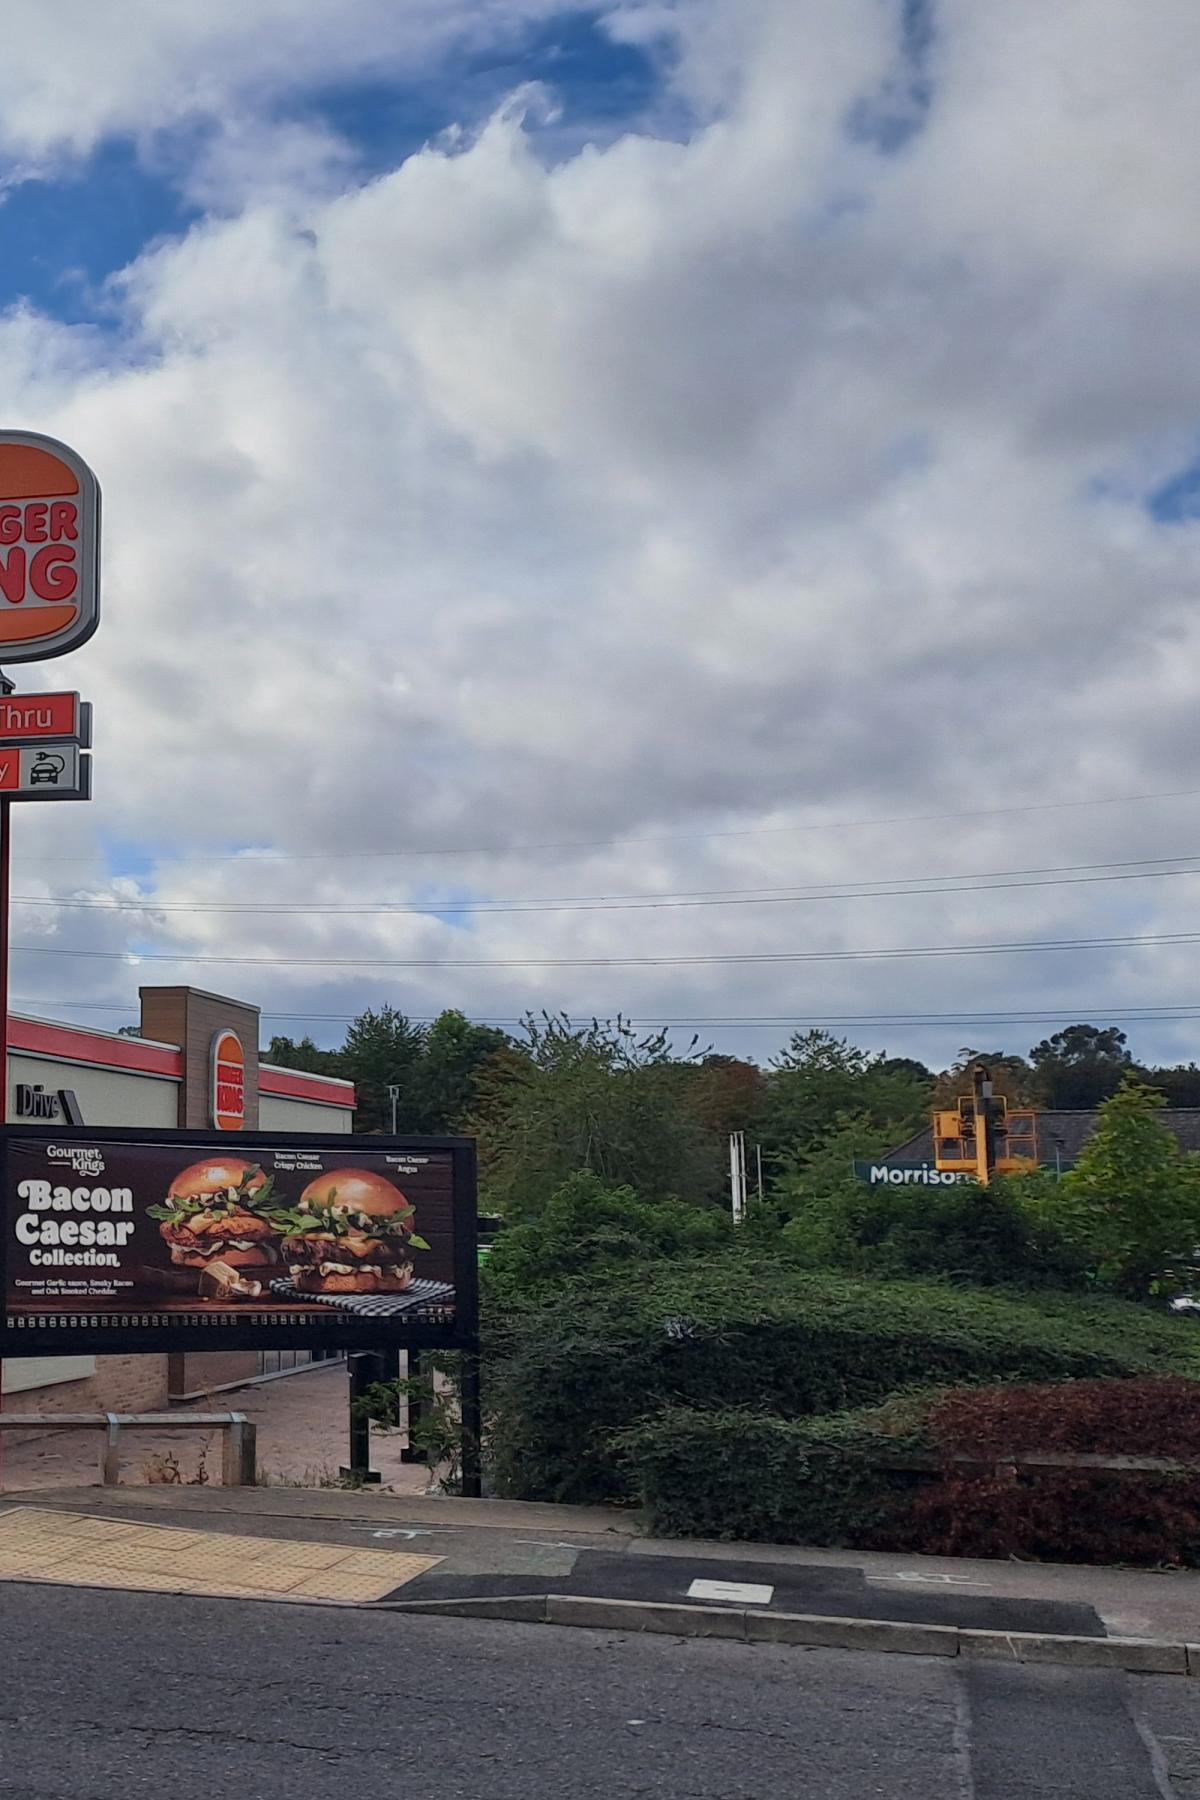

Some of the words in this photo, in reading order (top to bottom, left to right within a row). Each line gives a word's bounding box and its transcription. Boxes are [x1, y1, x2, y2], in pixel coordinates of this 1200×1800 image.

[16, 1084, 62, 1119] Drive
[46, 1144, 103, 1161] Gourmet
[71, 1158, 106, 1177] Kings
[870, 1162, 979, 1185] Morriso
[17, 1180, 134, 1212] Bacon
[15, 1213, 135, 1246] Caesar
[29, 1248, 121, 1268] Collection
